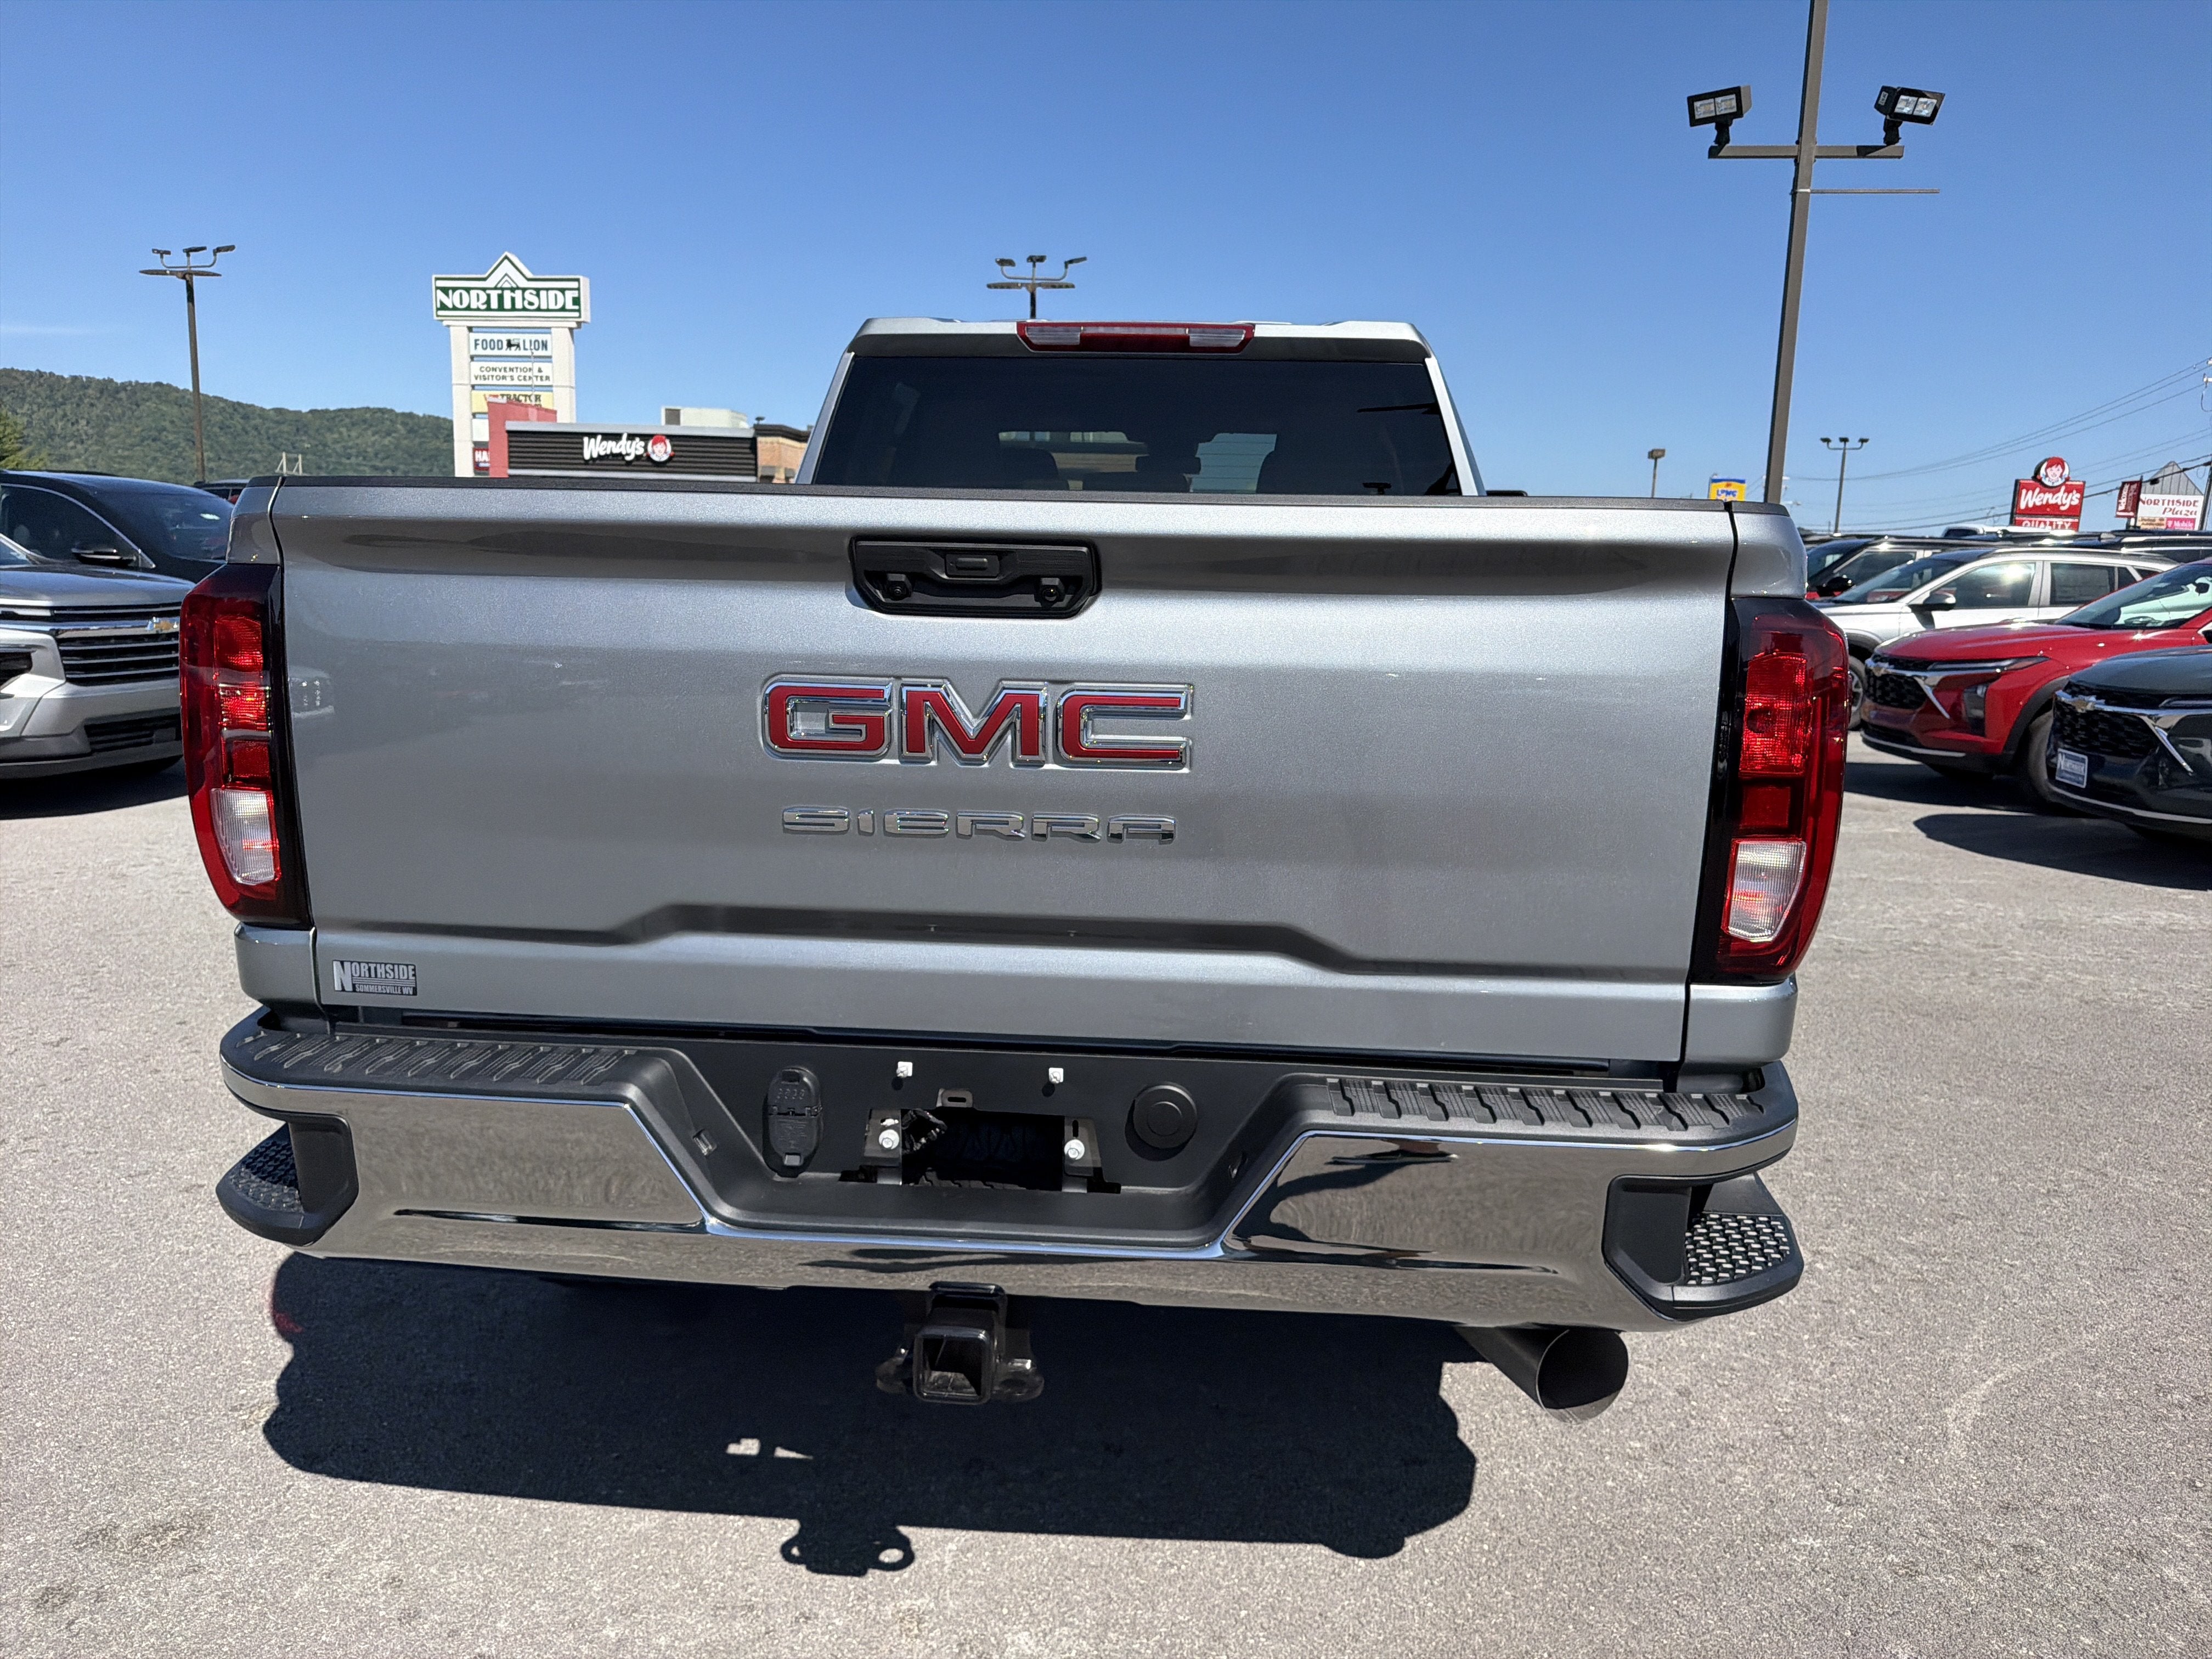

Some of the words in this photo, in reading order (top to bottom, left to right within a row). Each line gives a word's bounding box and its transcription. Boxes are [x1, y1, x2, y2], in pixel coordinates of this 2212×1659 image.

[437, 289, 579, 309] NORTHSIDE
[473, 338, 504, 351] FOOD
[522, 338, 548, 351] LION
[583, 433, 645, 461] Wendy's
[475, 450, 490, 462] HA
[2019, 486, 2081, 511] Wendy's
[2140, 498, 2199, 507] NORTHSIDE
[2162, 507, 2197, 516] Plaza
[2022, 521, 2071, 529] QUALITY
[763, 675, 1193, 772] GMC
[782, 805, 1176, 843] SIERRA
[333, 961, 415, 991] NORTHSIDE
[402, 986, 413, 995] WV
